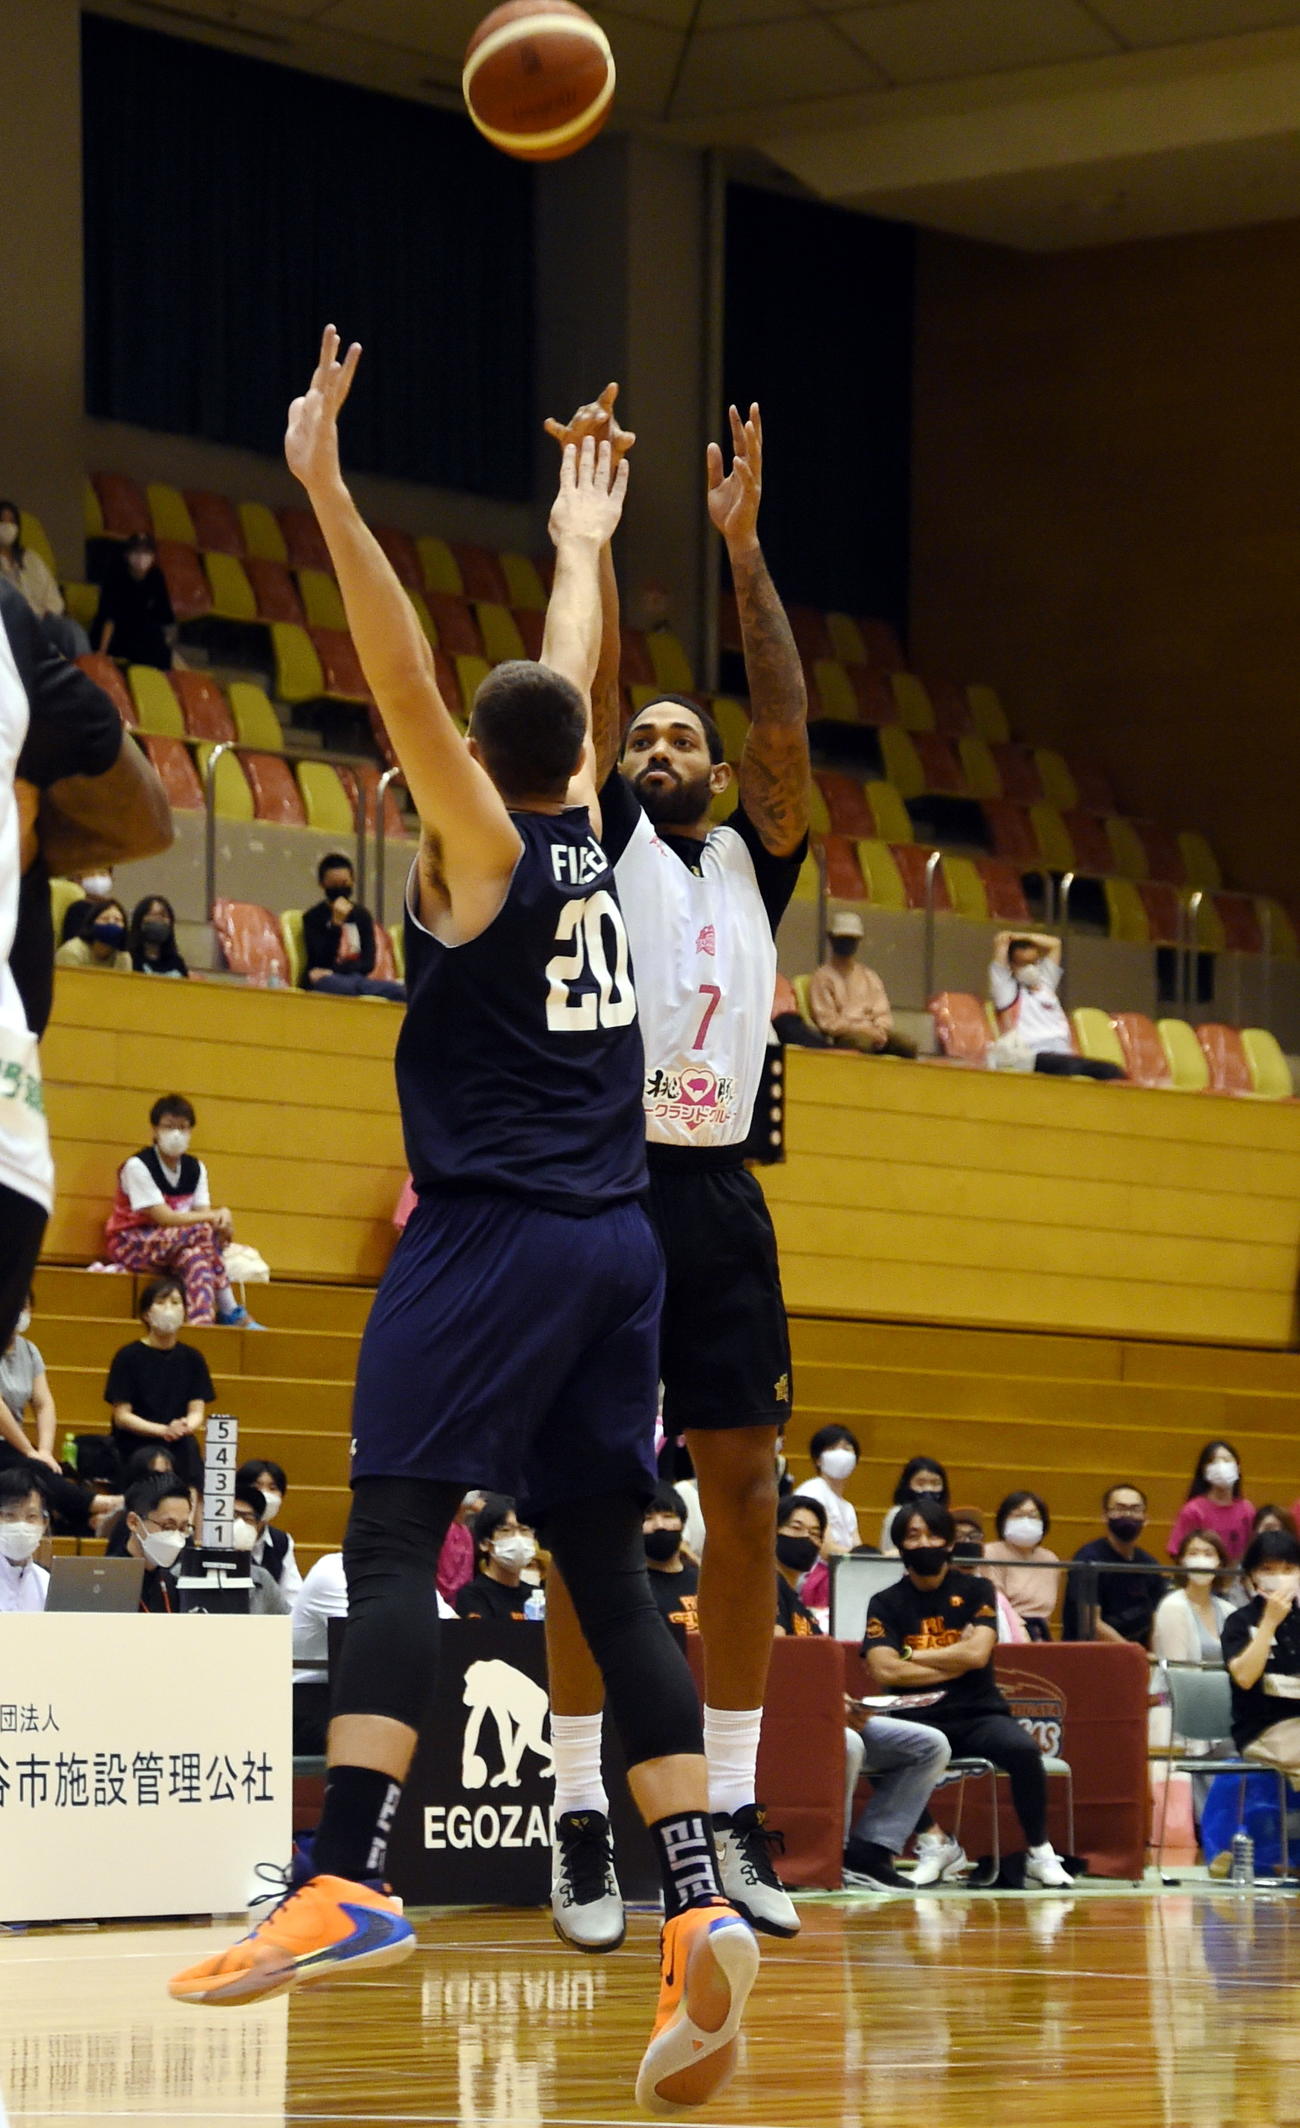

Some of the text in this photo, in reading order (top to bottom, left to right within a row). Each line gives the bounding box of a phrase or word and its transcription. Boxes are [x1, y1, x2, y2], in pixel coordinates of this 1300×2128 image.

[546, 890, 636, 1031] 20
[692, 985, 722, 1050] 7
[217, 1421, 229, 1440] 5
[216, 1447, 228, 1465] 4
[215, 1473, 227, 1491] 3
[214, 1499, 226, 1517] 2
[214, 1525, 224, 1543] 1
[424, 1805, 554, 1849] EGOZA
